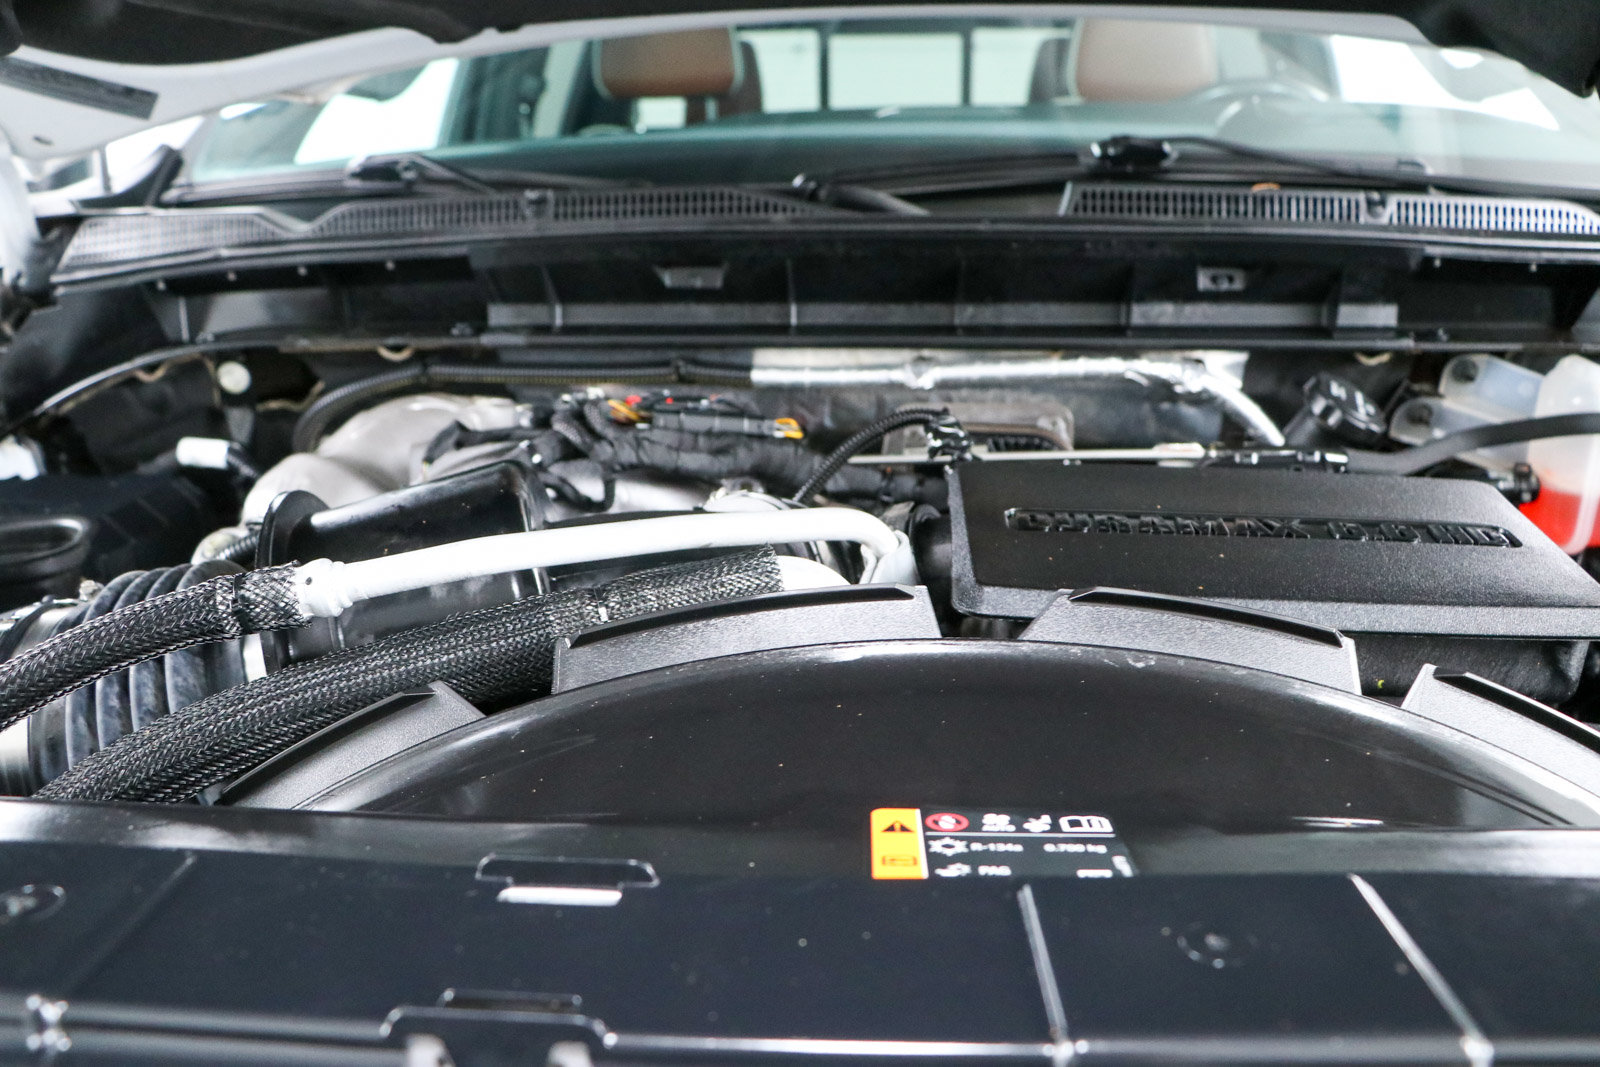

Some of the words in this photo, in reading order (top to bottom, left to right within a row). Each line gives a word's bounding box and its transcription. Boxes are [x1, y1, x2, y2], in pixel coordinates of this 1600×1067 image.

[1016, 511, 1310, 540] DURAMAX
[971, 842, 1024, 853] R-134a
[1087, 843, 1107, 854] kg
[979, 866, 1012, 876] PAG
